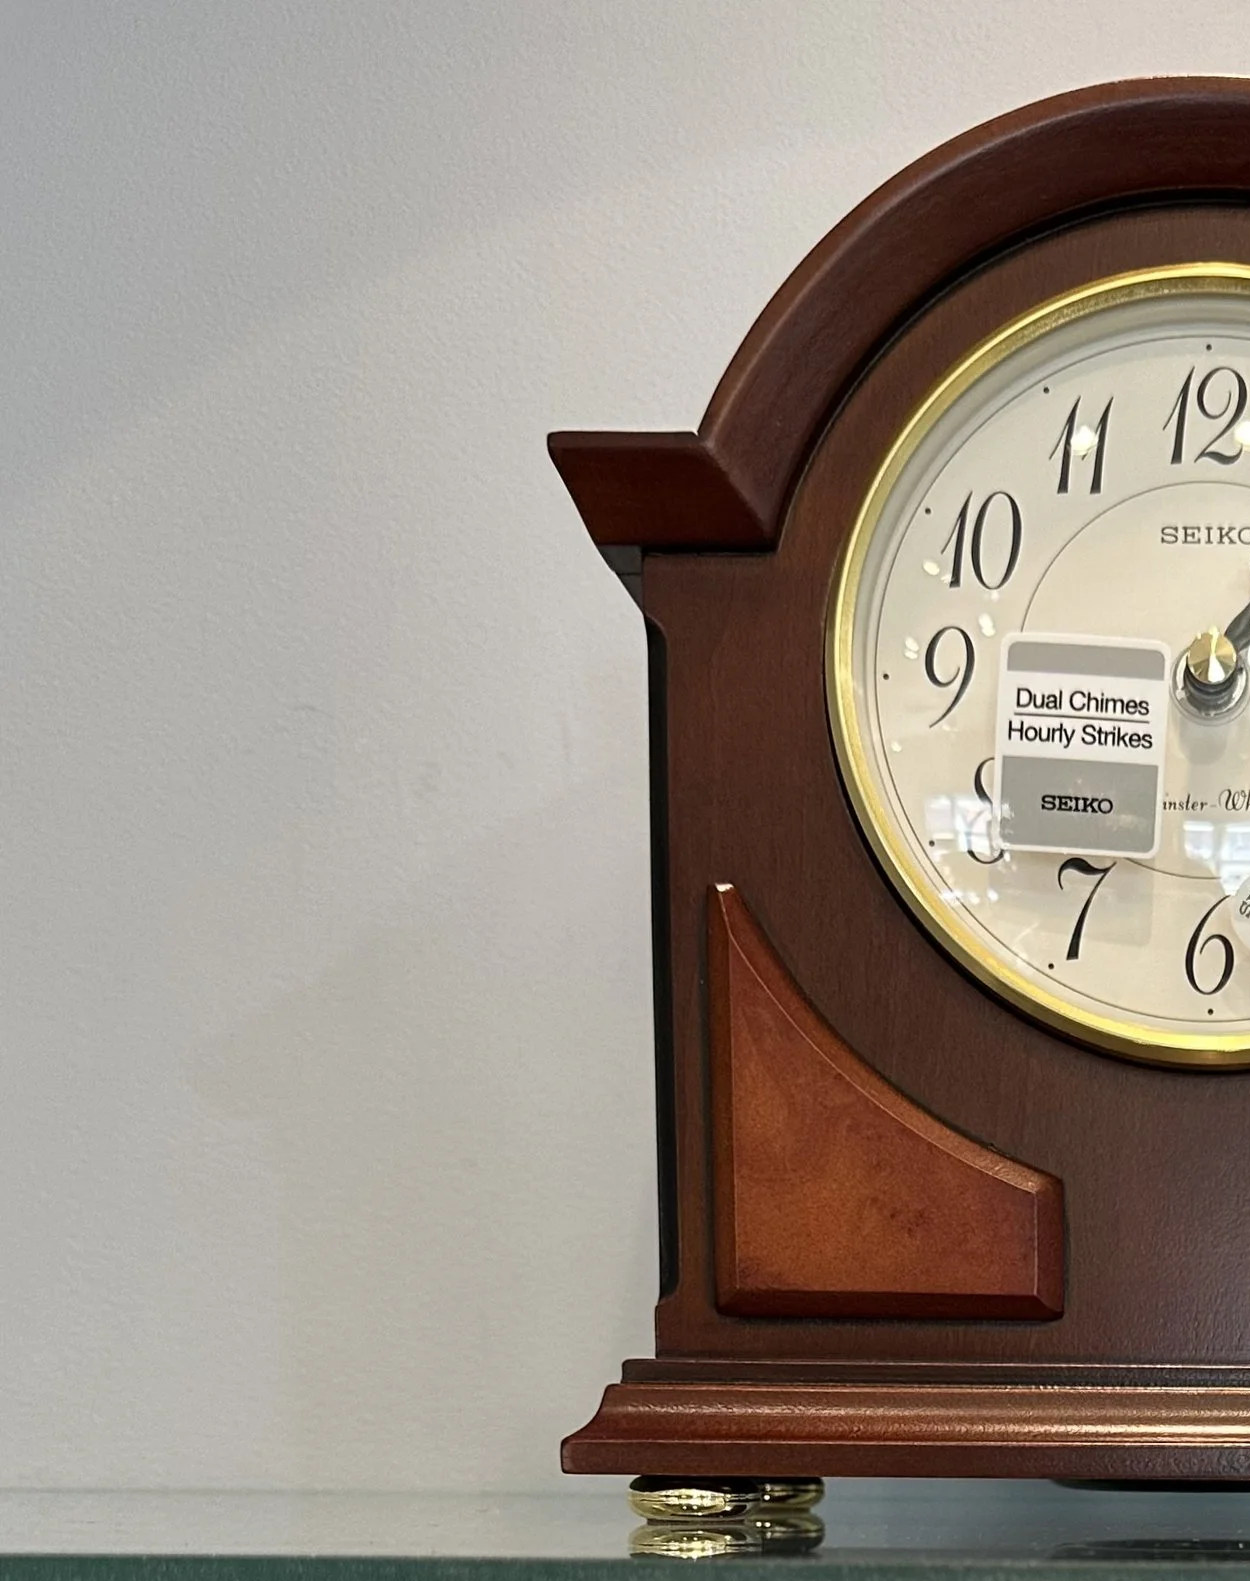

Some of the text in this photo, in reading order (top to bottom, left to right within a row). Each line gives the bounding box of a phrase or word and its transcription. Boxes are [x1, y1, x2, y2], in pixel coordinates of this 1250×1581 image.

[1049, 395, 1114, 494] 11
[1162, 366, 1248, 465] 12
[941, 490, 1022, 590] 10
[925, 626, 975, 729] 9
[1015, 687, 1150, 715] Dual Chimes
[1008, 721, 1153, 749] Hourly Strikes
[1041, 794, 1114, 815] SEIKO
[1057, 857, 1117, 960] 7
[1185, 894, 1234, 995] 6
